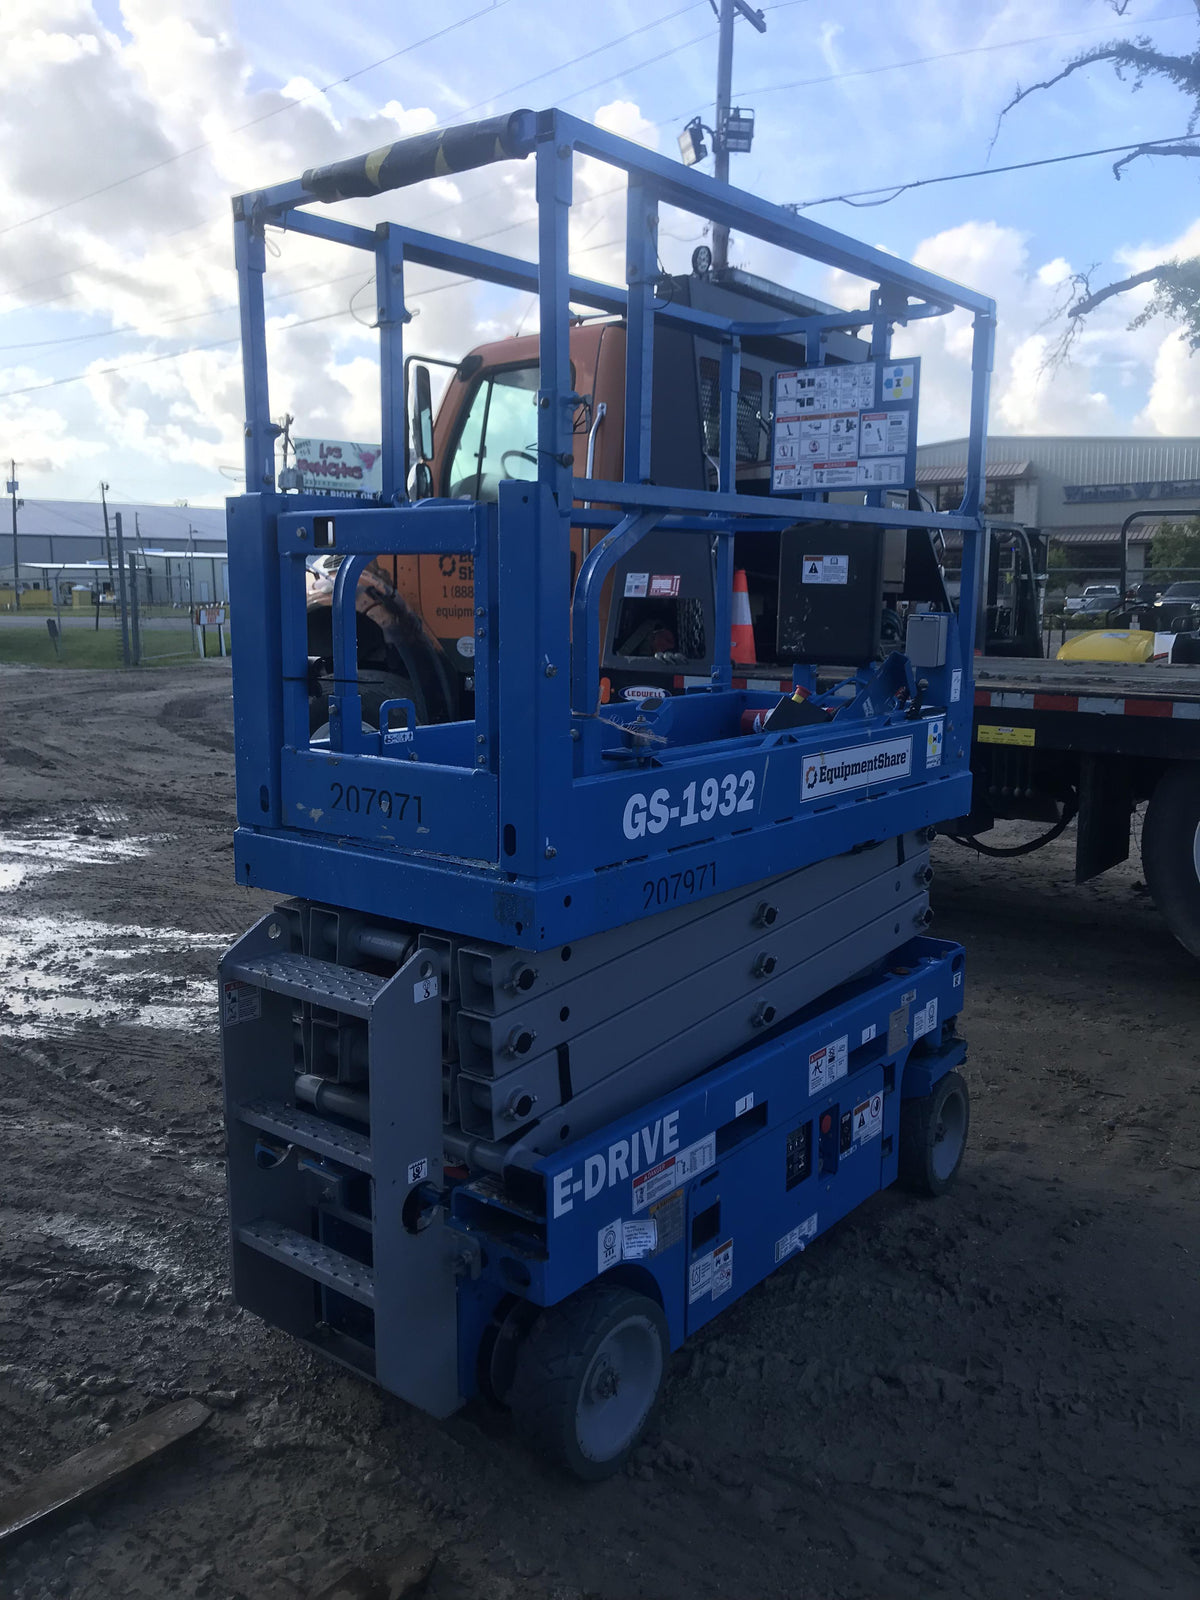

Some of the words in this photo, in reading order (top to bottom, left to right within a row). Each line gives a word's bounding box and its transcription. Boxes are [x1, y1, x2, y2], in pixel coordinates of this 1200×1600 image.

[459, 566, 474, 580] Sh
[443, 585, 448, 598] 1
[436, 604, 474, 619] equipm
[627, 690, 662, 698] LEDWELL
[818, 751, 906, 785] EquipmentShare
[330, 782, 422, 824] 207971
[623, 769, 756, 840] GS-1932
[643, 861, 716, 910] 207971
[553, 1109, 680, 1220] E-DRIVE
